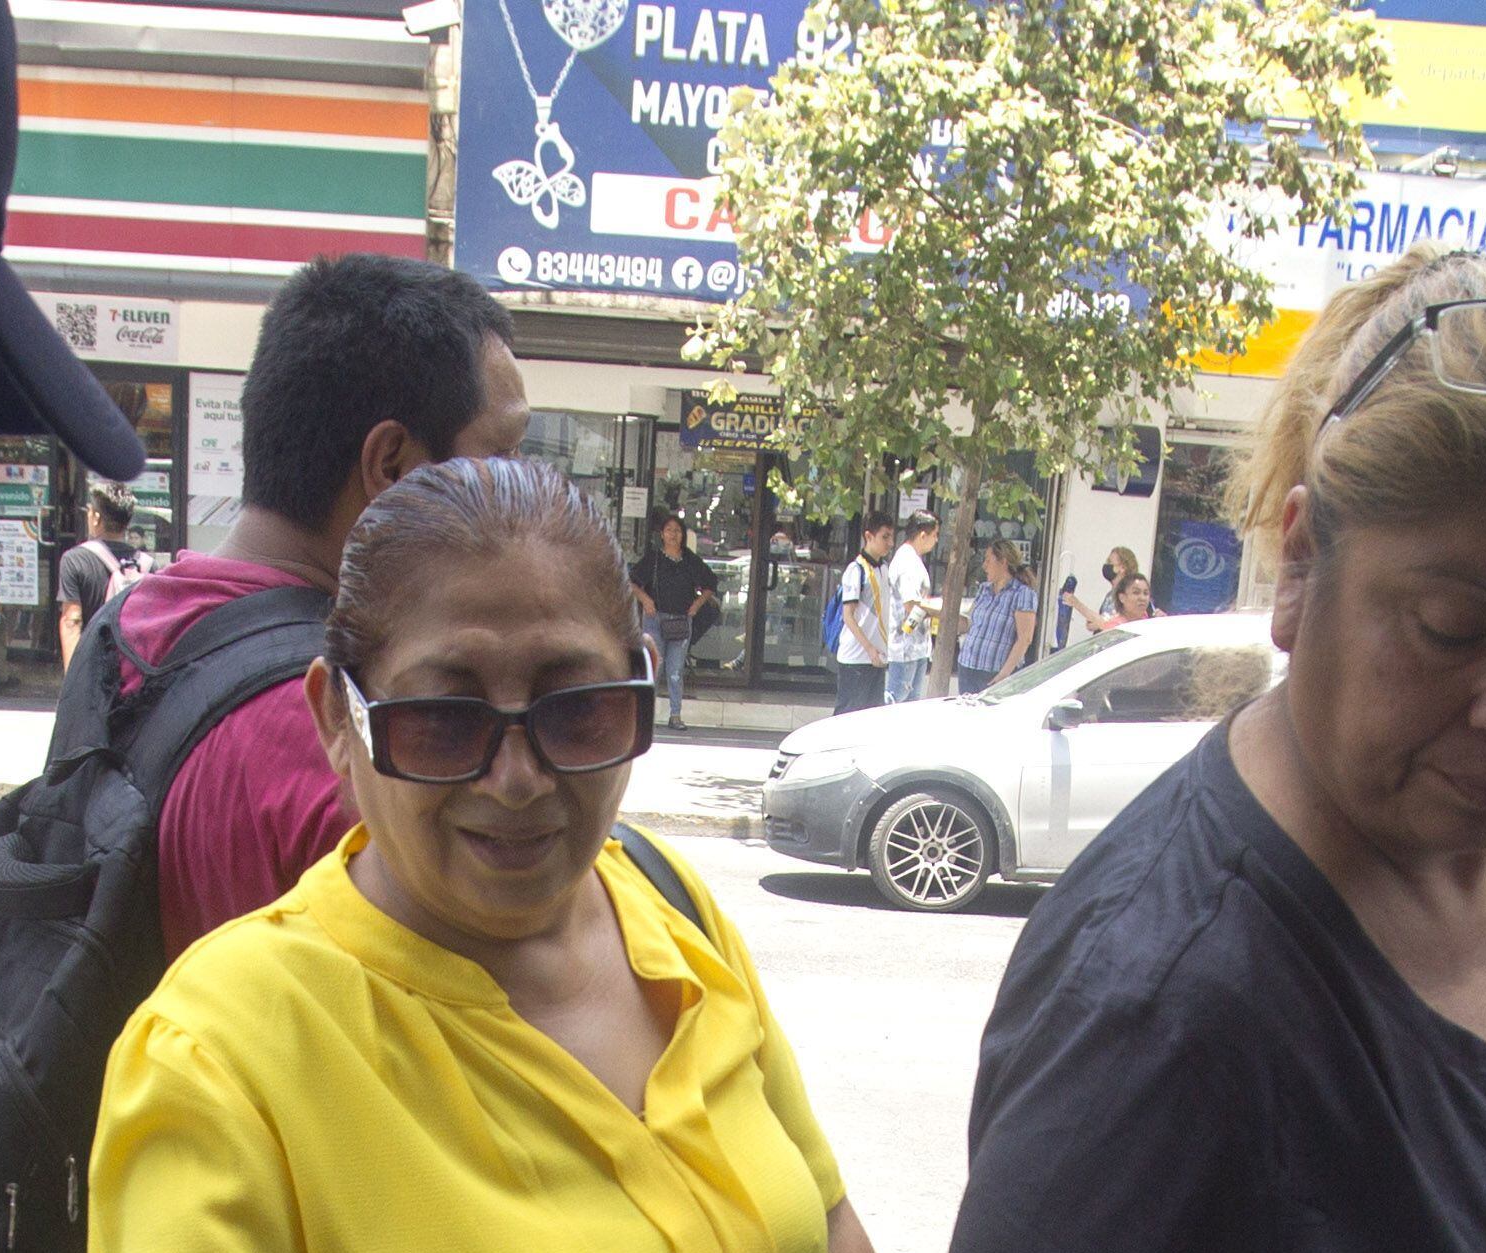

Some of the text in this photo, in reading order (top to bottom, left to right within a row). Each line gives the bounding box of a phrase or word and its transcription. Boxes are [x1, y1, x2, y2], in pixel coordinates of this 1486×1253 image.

[635, 3, 870, 76] PLATA 92
[733, 404, 782, 415] ANILL
